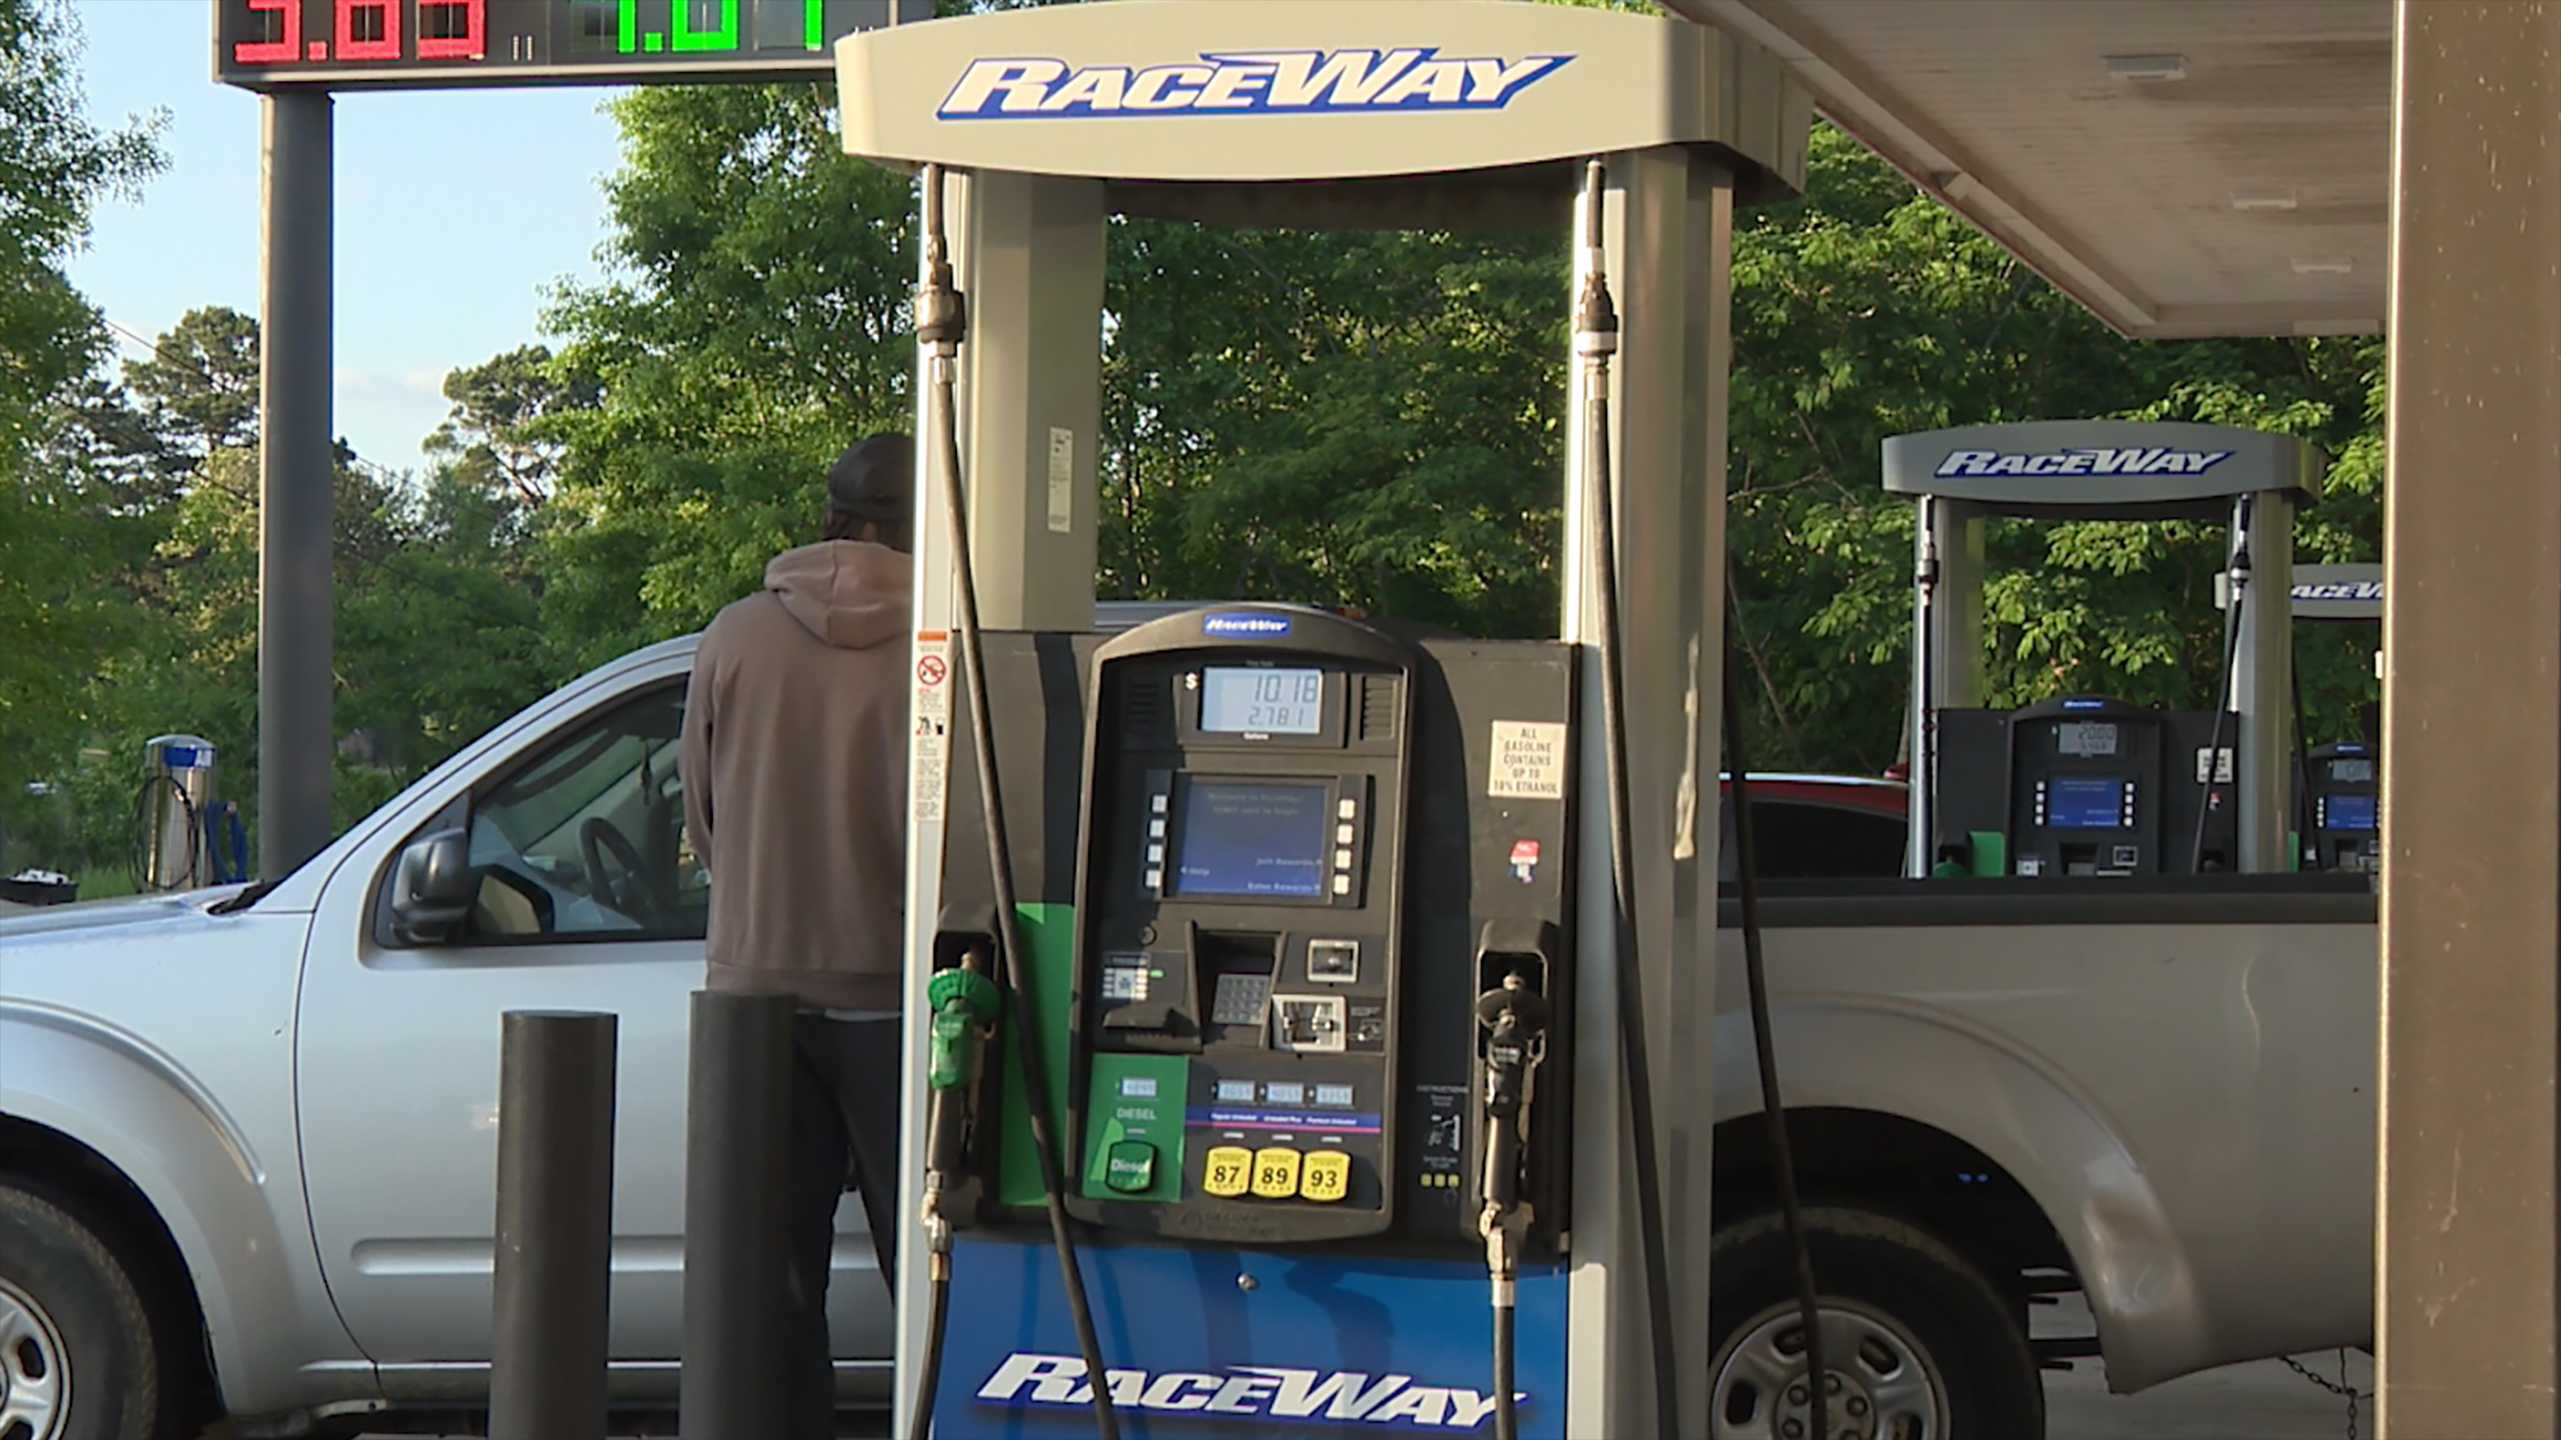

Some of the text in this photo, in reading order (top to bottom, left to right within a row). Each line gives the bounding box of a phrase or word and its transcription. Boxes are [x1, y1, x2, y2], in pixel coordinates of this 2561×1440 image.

[937, 48, 1577, 119] RACEWAY
[1935, 448, 2234, 477] RACEWAY
[1520, 728, 1537, 739] ALL
[1504, 742, 1552, 753] GASOLINE
[1503, 754, 1551, 766] CONTAINS
[1512, 768, 1540, 779] UP TO
[1494, 780, 1558, 794] 10% ETHANOL
[1116, 1107, 1157, 1120] DIESEL
[1213, 1165, 1240, 1185] 87
[1261, 1166, 1288, 1186] 89
[1311, 1169, 1338, 1189] 93
[976, 1353, 1526, 1427] RACEWAY
